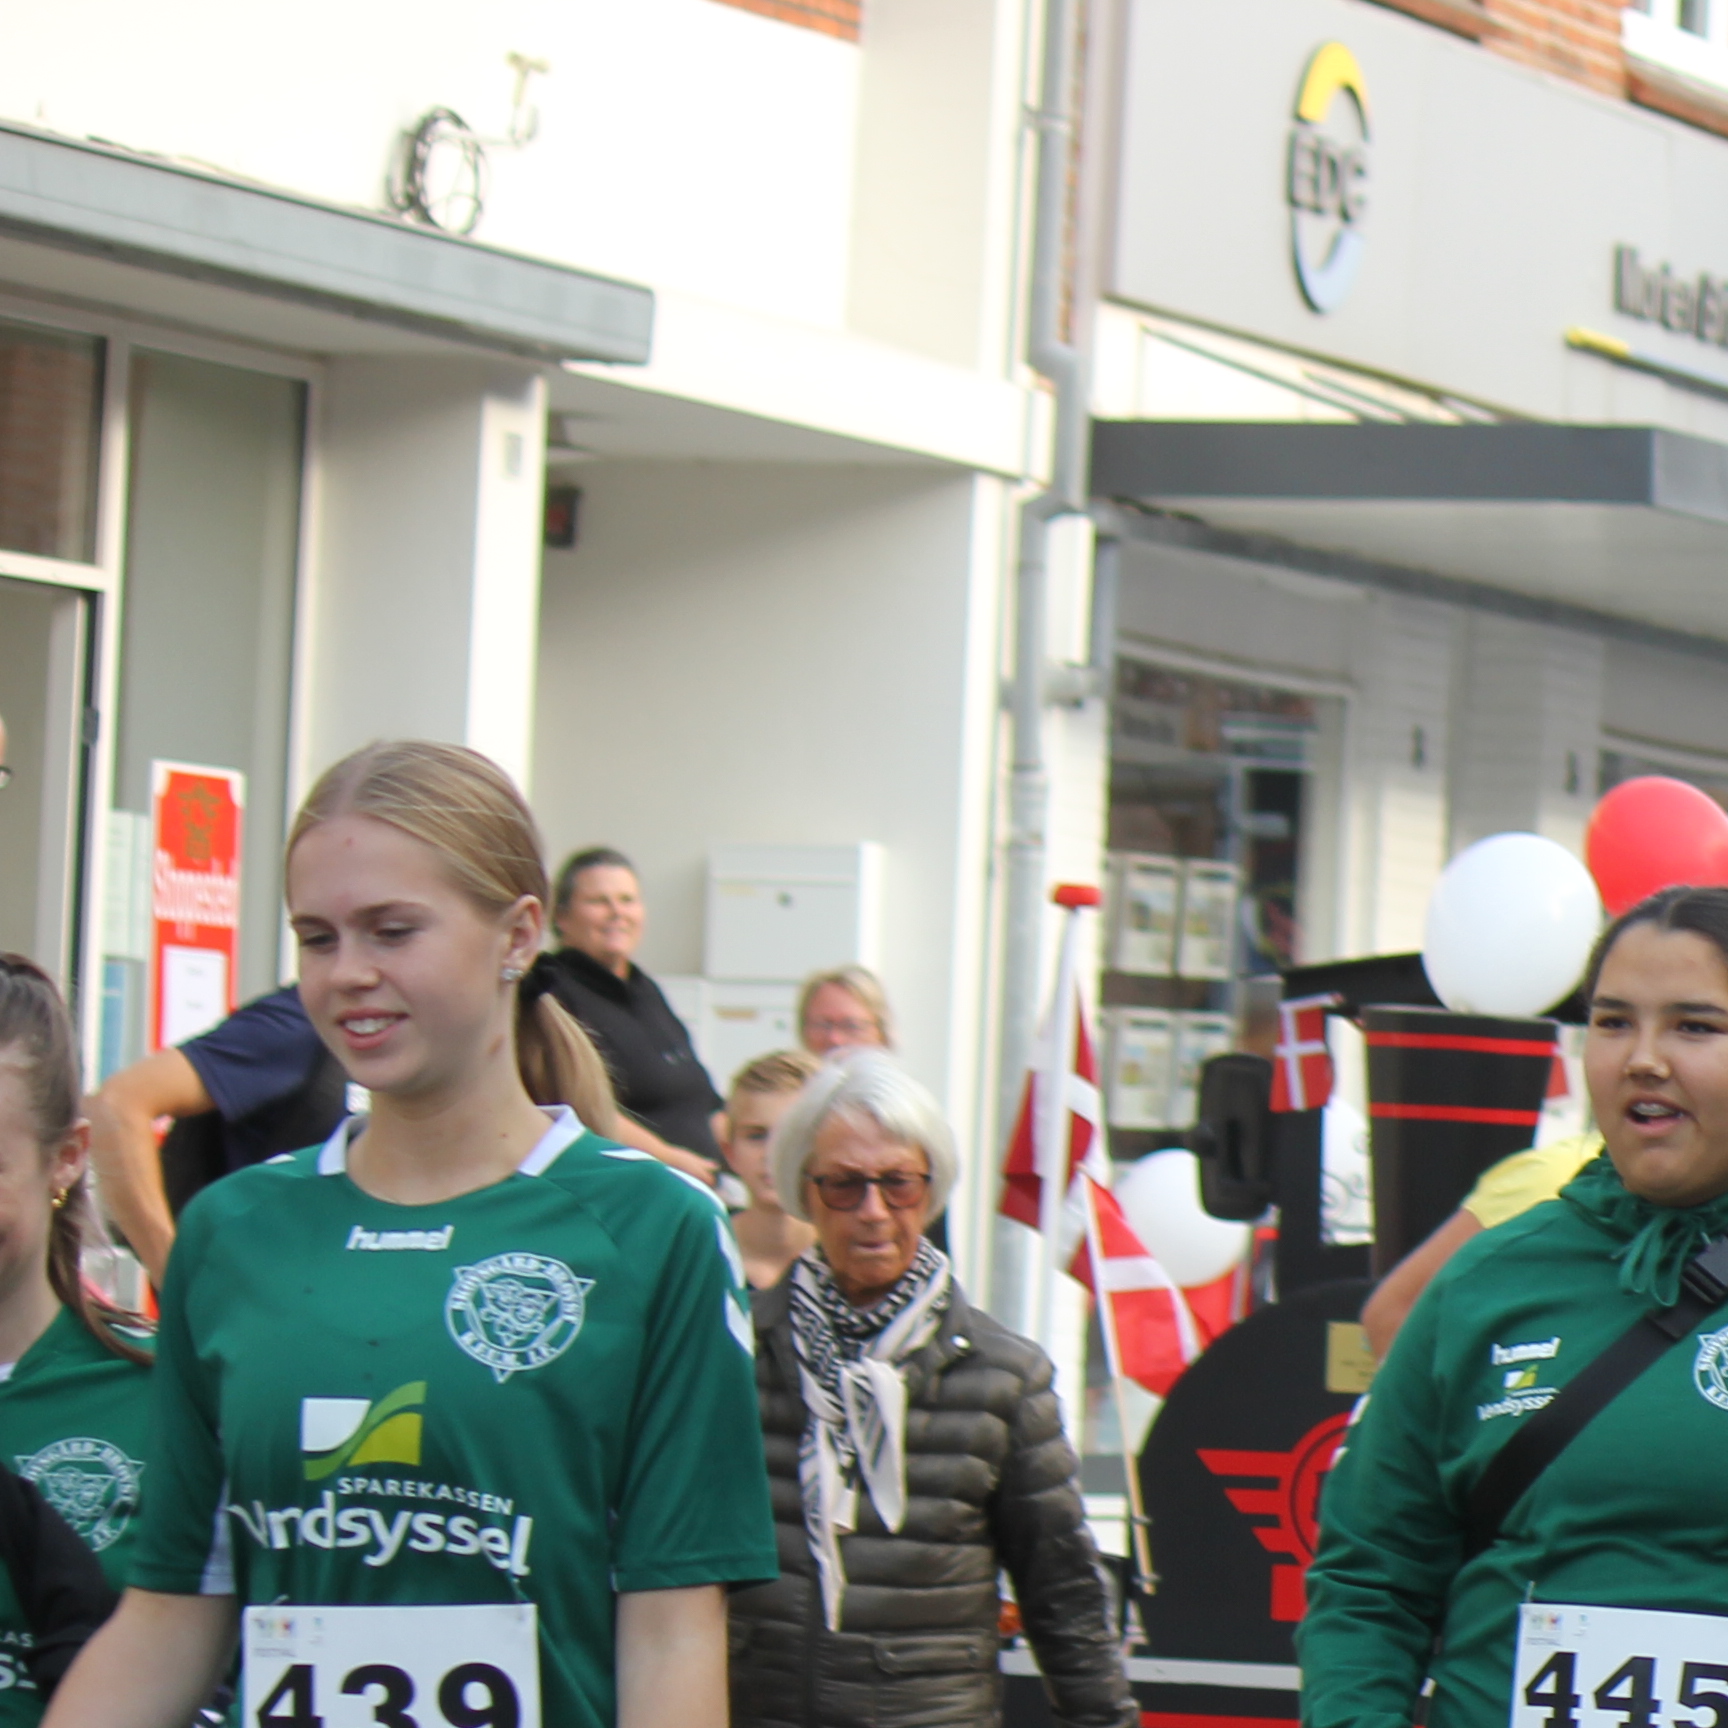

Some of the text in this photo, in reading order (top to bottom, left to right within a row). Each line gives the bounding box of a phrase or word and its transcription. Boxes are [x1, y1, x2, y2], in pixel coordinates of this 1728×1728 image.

[1287, 128, 1368, 222] EDC
[346, 1225, 455, 1250] hummel
[338, 1477, 514, 1516] SPAREKASSEN
